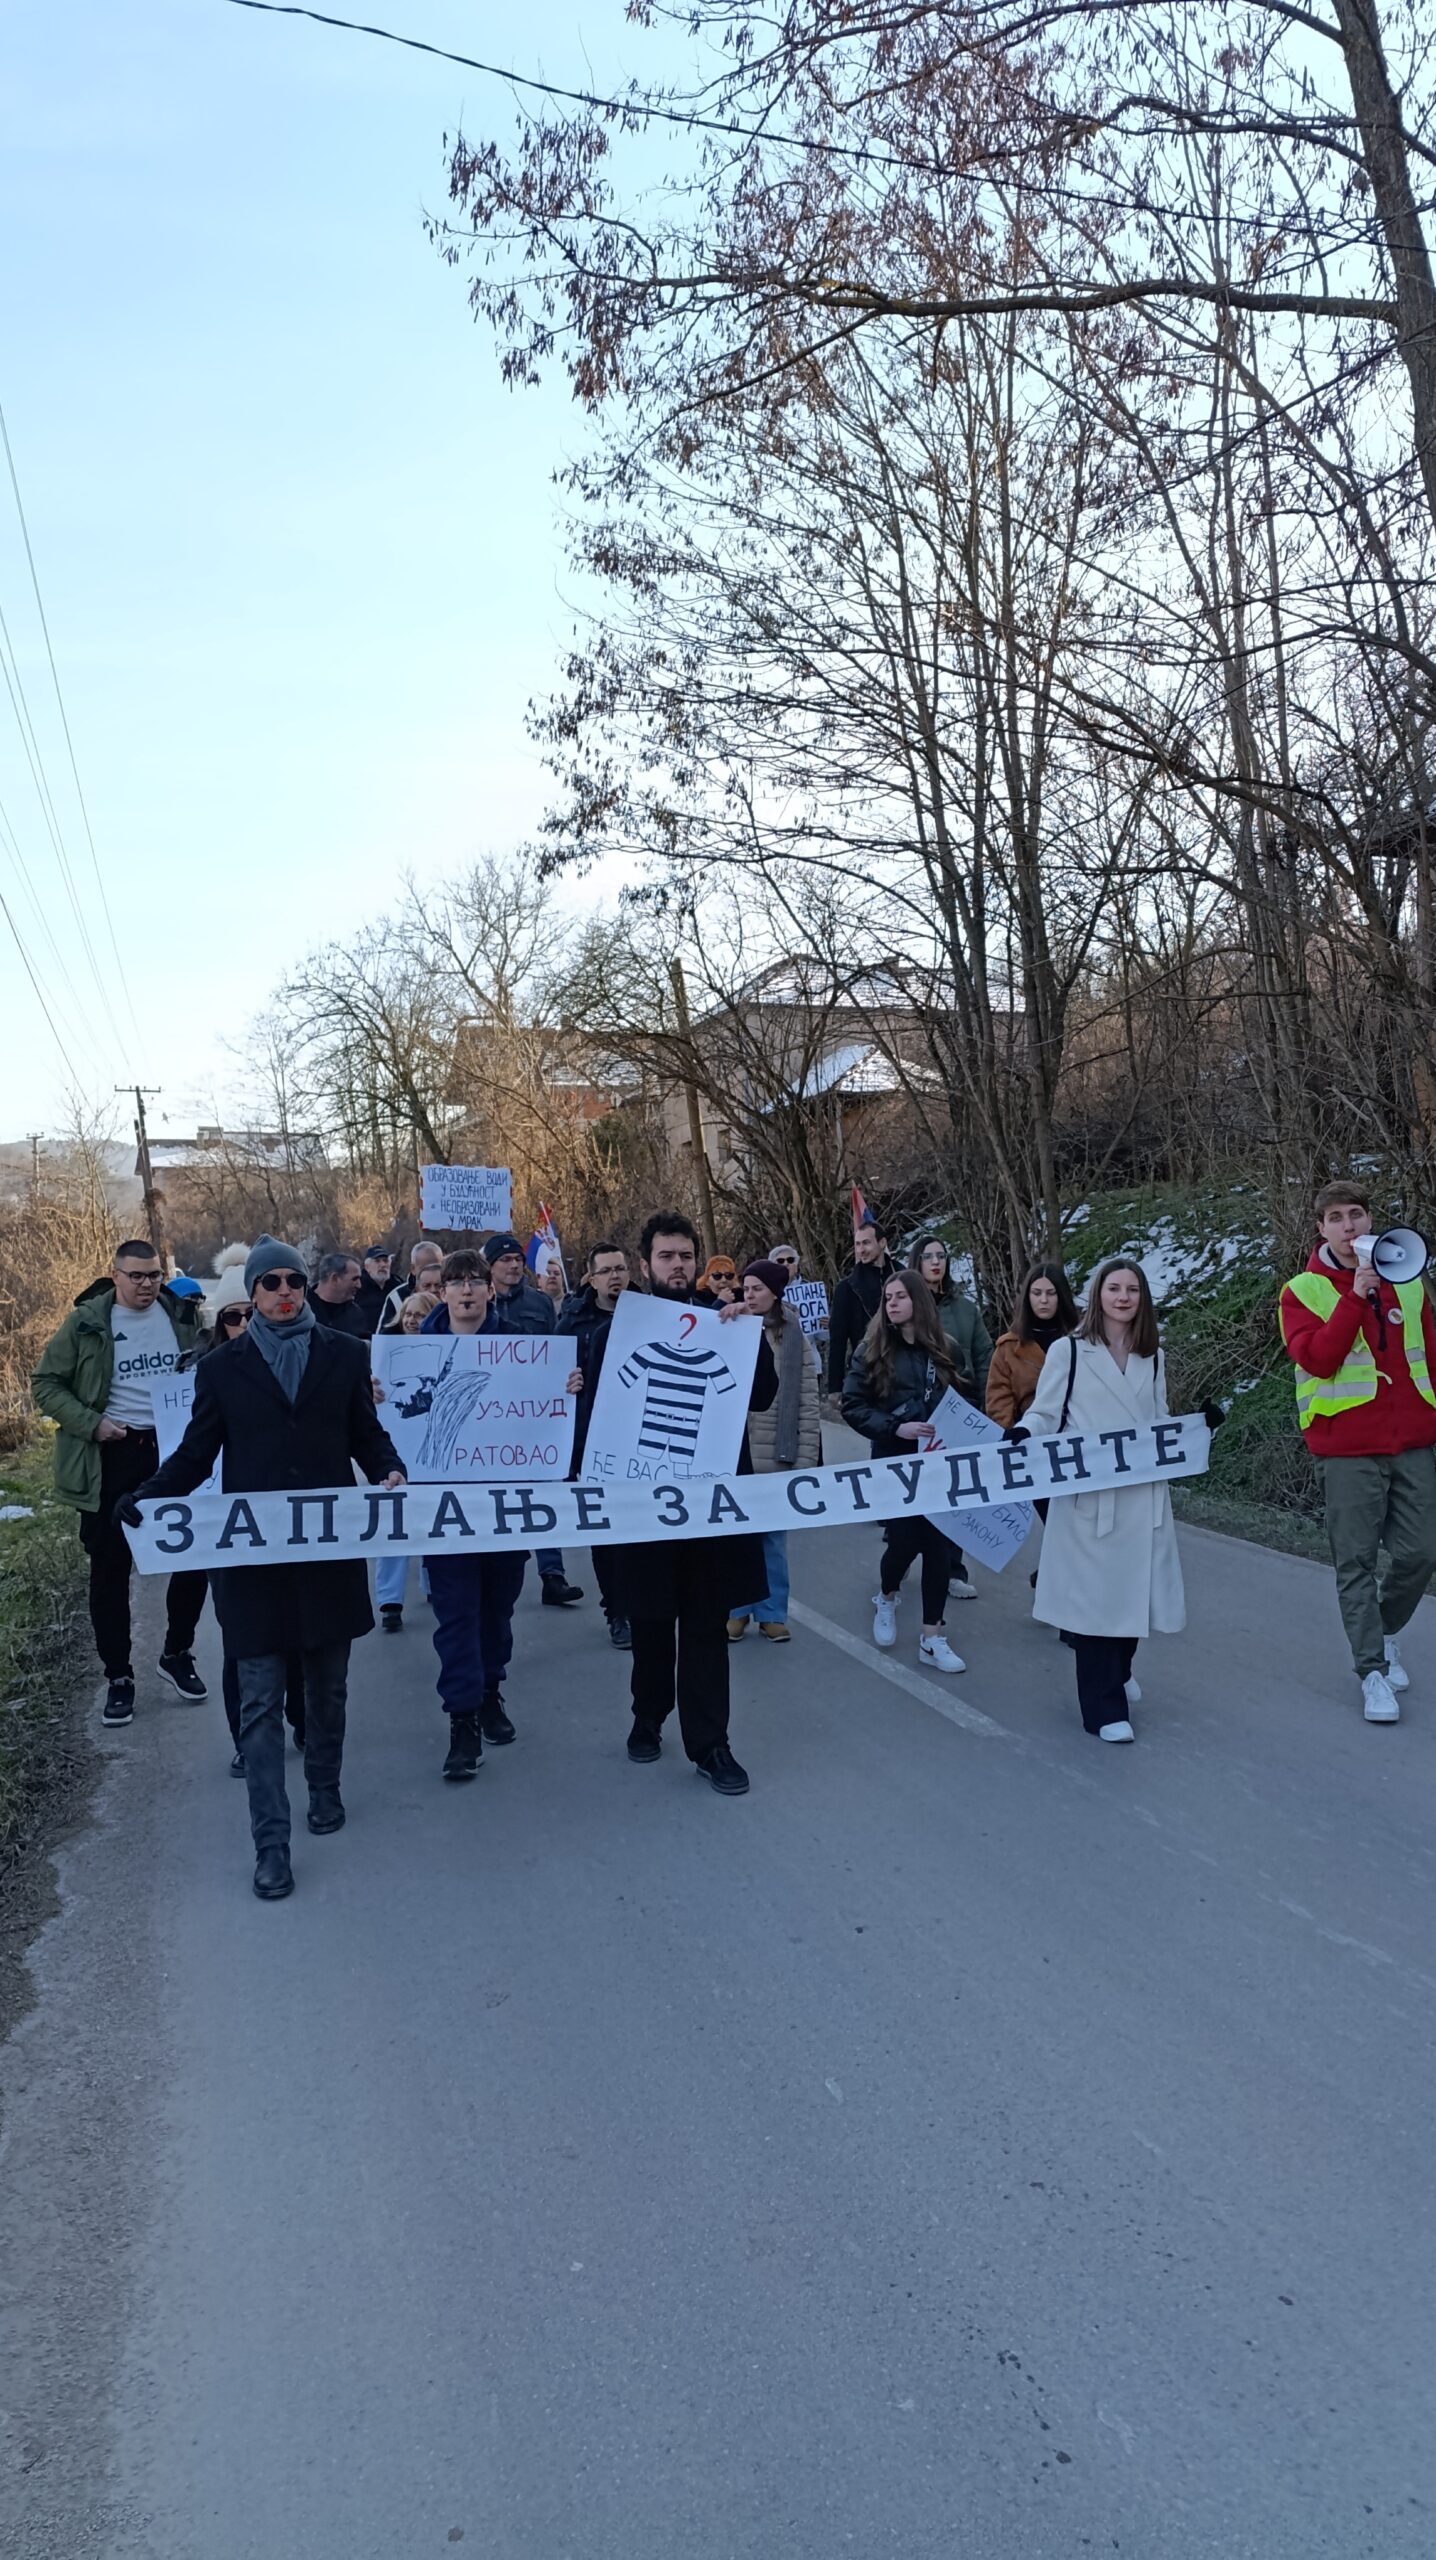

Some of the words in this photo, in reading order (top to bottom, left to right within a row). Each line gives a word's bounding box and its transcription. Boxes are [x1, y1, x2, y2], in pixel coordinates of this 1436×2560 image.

[427, 1167, 480, 1184] ОБРАЗОВАЊЕ
[486, 1170, 508, 1186] ВОДИ
[441, 1184, 446, 1197] У
[440, 1199, 501, 1216] НЕОБРАЗОВАНИ
[448, 1215, 455, 1228] У
[458, 1215, 483, 1230] МРАК
[786, 1282, 826, 1303] ПЛАЊЕ
[799, 1300, 827, 1318] ОГА
[478, 1340, 548, 1365] НИСИ
[119, 1367, 175, 1381] SPORTSWE
[476, 1398, 567, 1420] УЗАПУД
[946, 1396, 961, 1414] НЕ
[963, 1412, 989, 1436] БИ
[455, 1444, 559, 1467] РАТОВАО
[592, 1451, 616, 1475] ЋЕ
[153, 1486, 612, 1554] ЗАПЛАЊЕ
[652, 1483, 749, 1527] ЗА
[786, 1422, 1188, 1516] СТУДЕНТЕ
[961, 1513, 1005, 1549] ЗАКОНУ
